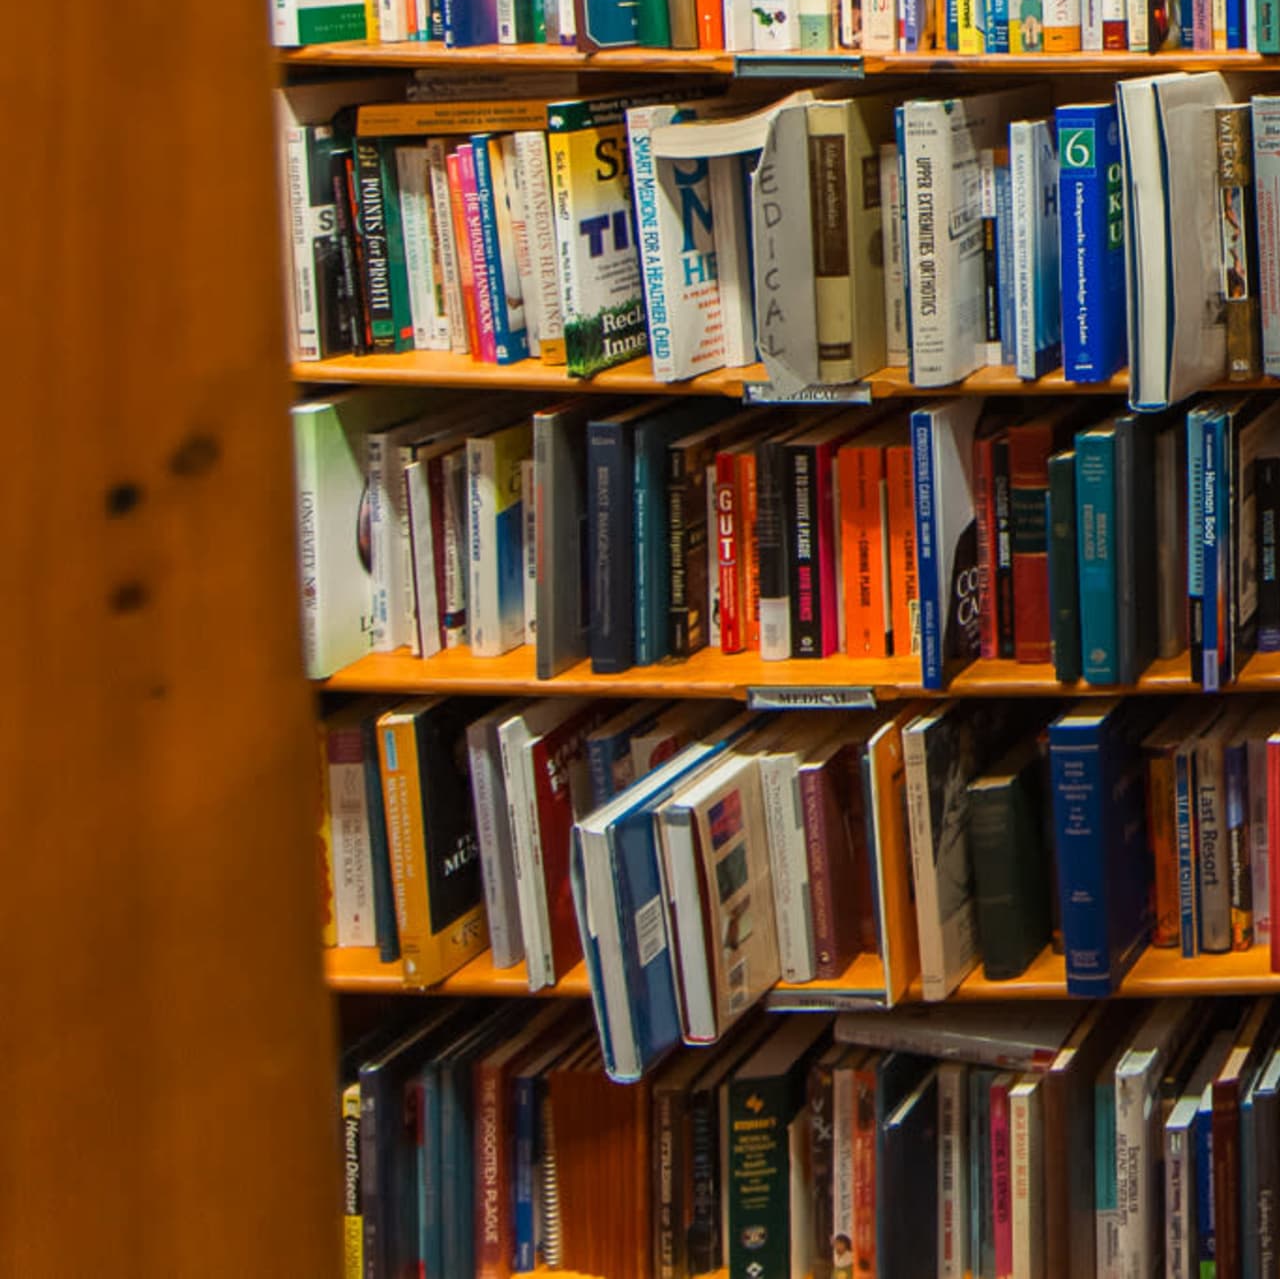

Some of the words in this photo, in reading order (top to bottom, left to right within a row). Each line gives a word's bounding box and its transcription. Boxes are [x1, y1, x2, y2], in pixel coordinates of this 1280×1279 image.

[555, 151, 567, 172] Sick
[634, 136, 651, 174] SMART
[1066, 132, 1090, 167] 6
[1219, 114, 1234, 180] VATICAN
[915, 157, 932, 189] UPPER
[362, 177, 382, 230] POINTS
[464, 193, 481, 213] THE
[557, 190, 570, 220] Tired?
[637, 178, 657, 228] MEDICINE
[917, 192, 935, 256] EXTREMITIES
[1073, 180, 1087, 246] Orthopaedic
[366, 233, 384, 256] for
[467, 215, 486, 263] SHIATSU
[527, 138, 548, 251] SPONTANEOUS
[542, 255, 560, 334] HEALING
[644, 231, 658, 253] FOR
[647, 256, 659, 264] A
[1075, 247, 1090, 306] Knowledge
[368, 258, 389, 310] PROFIT
[473, 264, 492, 334] HANDBOOK
[648, 266, 667, 325] HEALTHIER
[919, 260, 936, 317] ORTHOTICS
[653, 327, 671, 360] CHILD
[1077, 307, 1090, 345] Update
[1204, 471, 1216, 513] Human
[300, 490, 316, 570] LONGEVITY
[719, 490, 734, 561] GUT
[1203, 516, 1216, 547] Body
[858, 539, 869, 573] COMING
[860, 575, 870, 608] PLAGUE
[777, 691, 849, 705] MEDICAL
[1200, 785, 1218, 821] Last
[1202, 829, 1220, 887] Resort
[483, 1080, 494, 1105] THE
[345, 1120, 359, 1160] Heart
[484, 1107, 497, 1186] FORGOTTEN
[345, 1161, 359, 1214] Disease
[486, 1189, 498, 1244] PLAGUE
